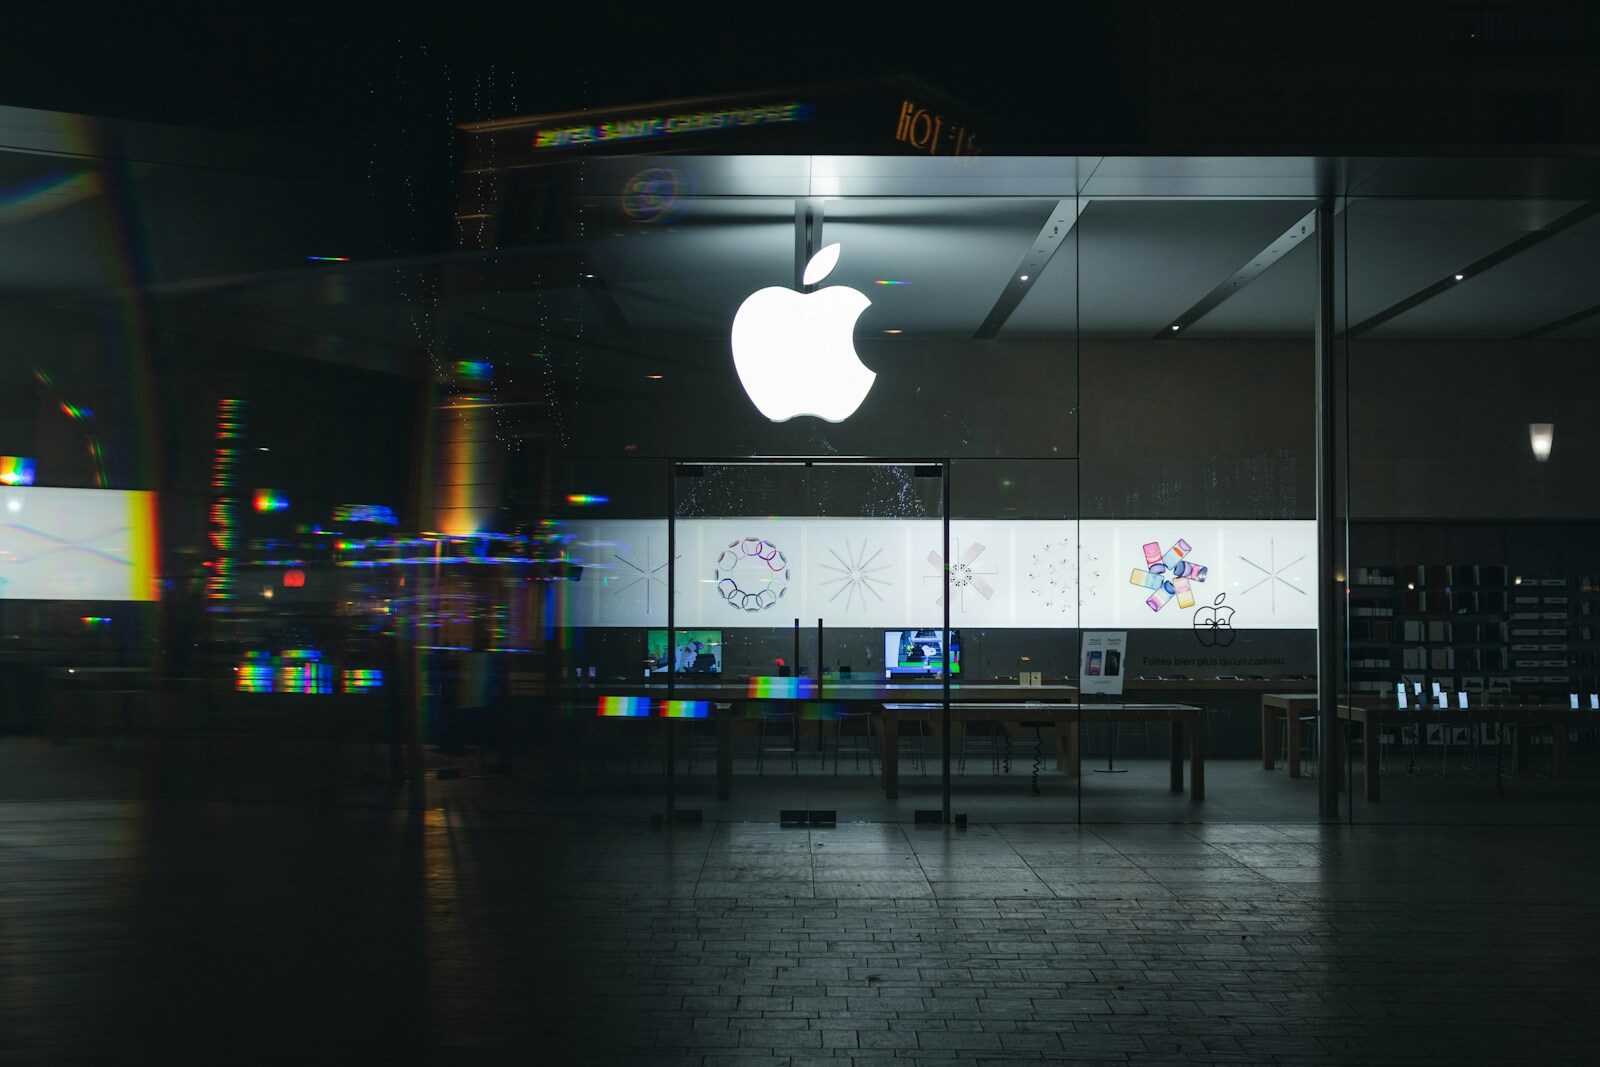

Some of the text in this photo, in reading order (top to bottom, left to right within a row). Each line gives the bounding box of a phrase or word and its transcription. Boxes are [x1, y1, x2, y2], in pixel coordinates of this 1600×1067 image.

[1143, 656, 1173, 666] Faites
[1174, 656, 1196, 666] bien
[1197, 656, 1217, 667] plus
[1219, 656, 1247, 667] qu'un
